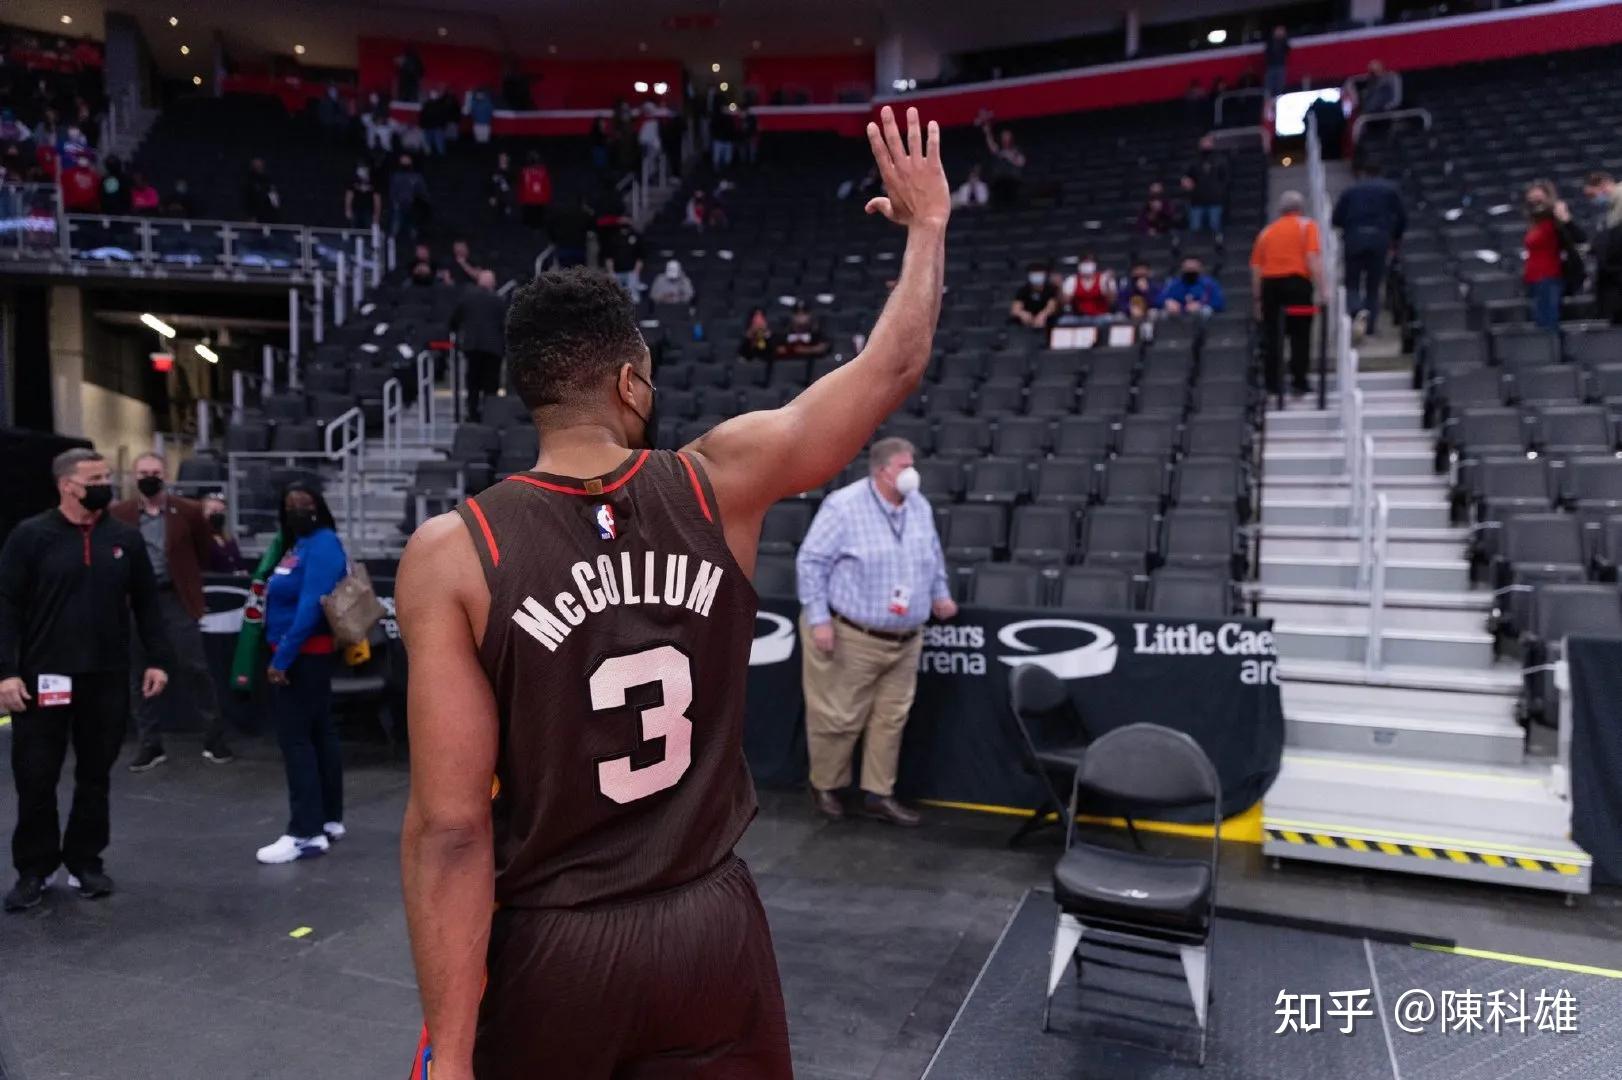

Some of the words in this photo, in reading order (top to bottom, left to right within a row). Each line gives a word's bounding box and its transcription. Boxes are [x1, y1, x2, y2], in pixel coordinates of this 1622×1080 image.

[511, 550, 724, 653] McCOLLUM
[923, 624, 985, 648] esars
[1133, 622, 1215, 655] Little
[1216, 622, 1277, 655] Cae
[918, 651, 987, 675] rena
[589, 645, 693, 804] 3
